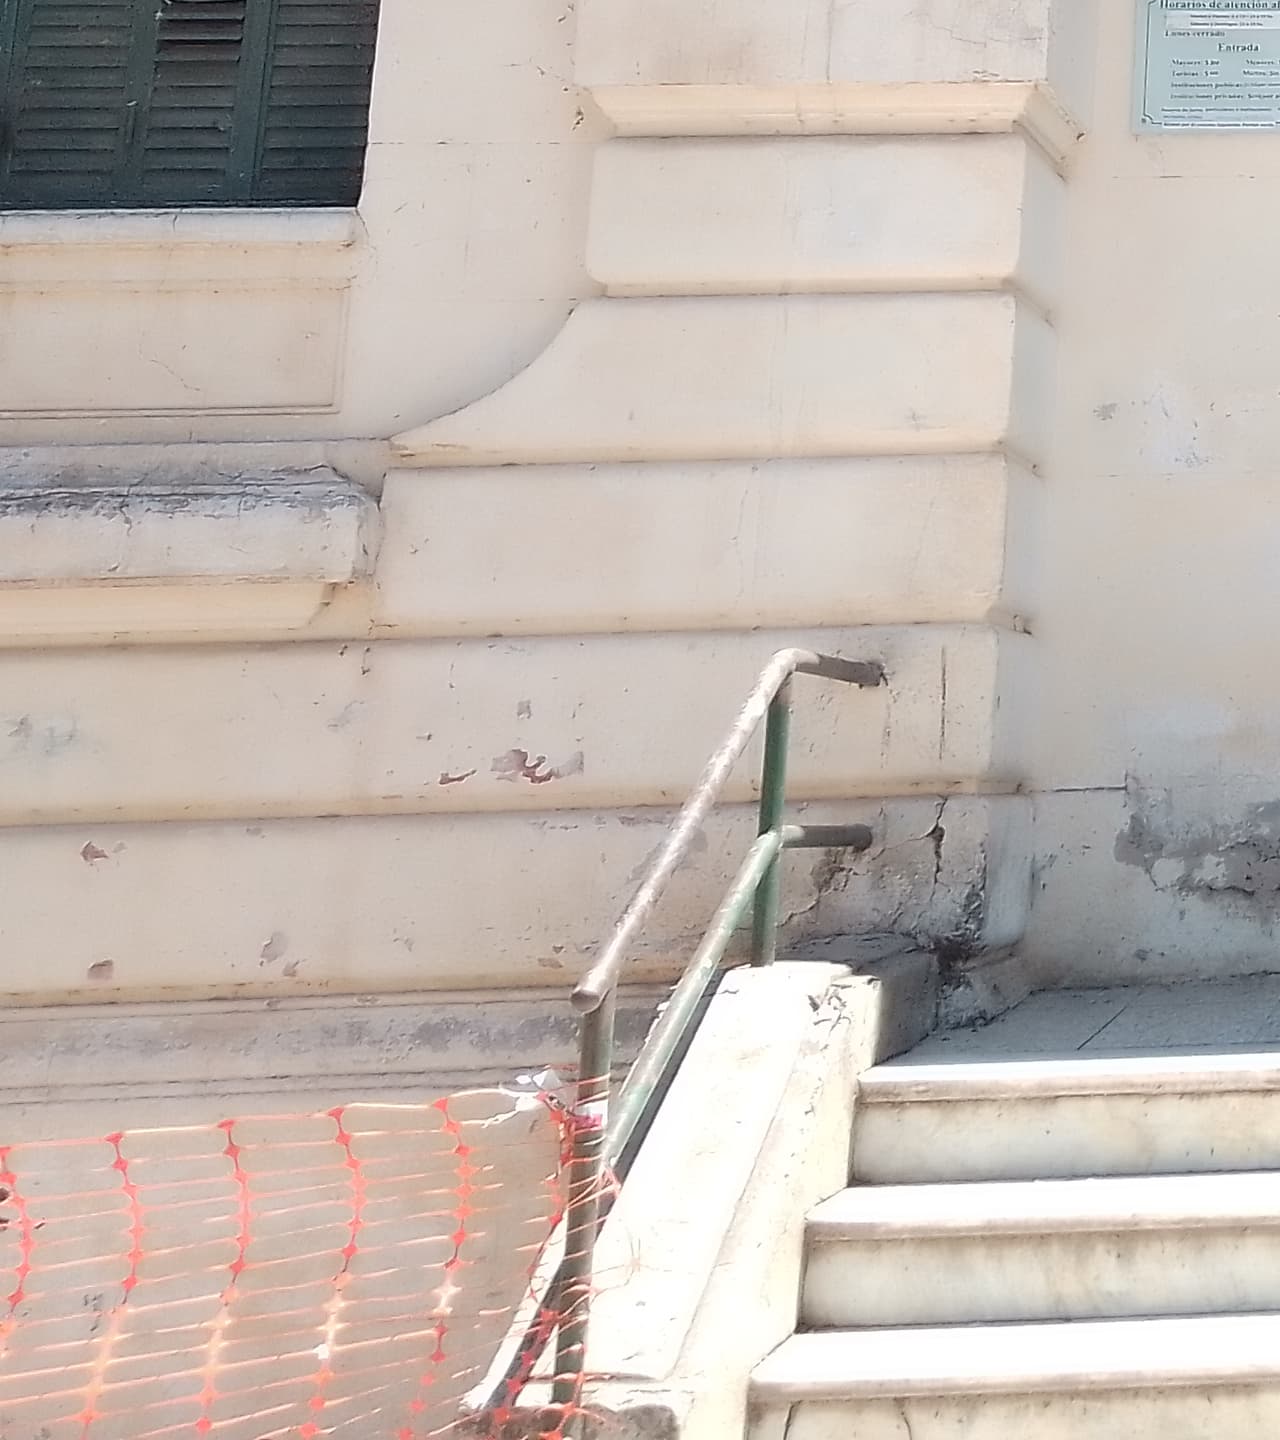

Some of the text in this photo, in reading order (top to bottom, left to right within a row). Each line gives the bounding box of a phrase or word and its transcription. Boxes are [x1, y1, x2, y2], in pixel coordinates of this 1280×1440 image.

[1159, 0, 1206, 9] Horarios
[1209, 0, 1221, 9] de
[1224, 0, 1269, 9] atención
[1271, 0, 1280, 9] al
[1218, 42, 1260, 52] Entrada
